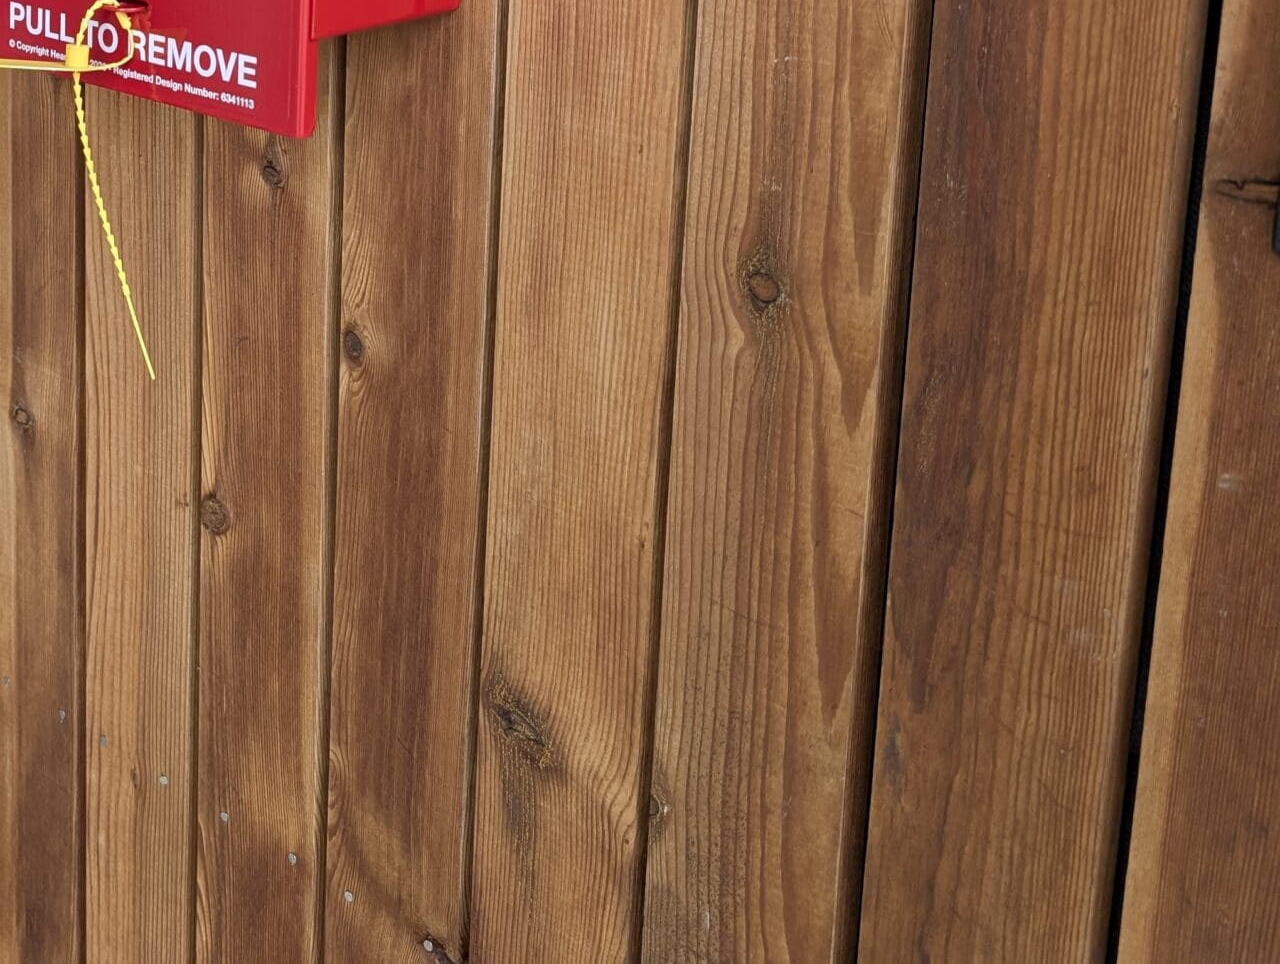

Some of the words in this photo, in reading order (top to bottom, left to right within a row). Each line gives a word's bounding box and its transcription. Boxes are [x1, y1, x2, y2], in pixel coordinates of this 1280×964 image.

[9, 1, 74, 43] PULL
[86, 19, 118, 53] TO
[129, 29, 257, 88] REMOVE
[17, 40, 49, 57] Copyright
[113, 65, 153, 84] Registered
[156, 75, 182, 92] Design
[184, 83, 219, 100] Number:
[221, 92, 254, 109] 6341113
